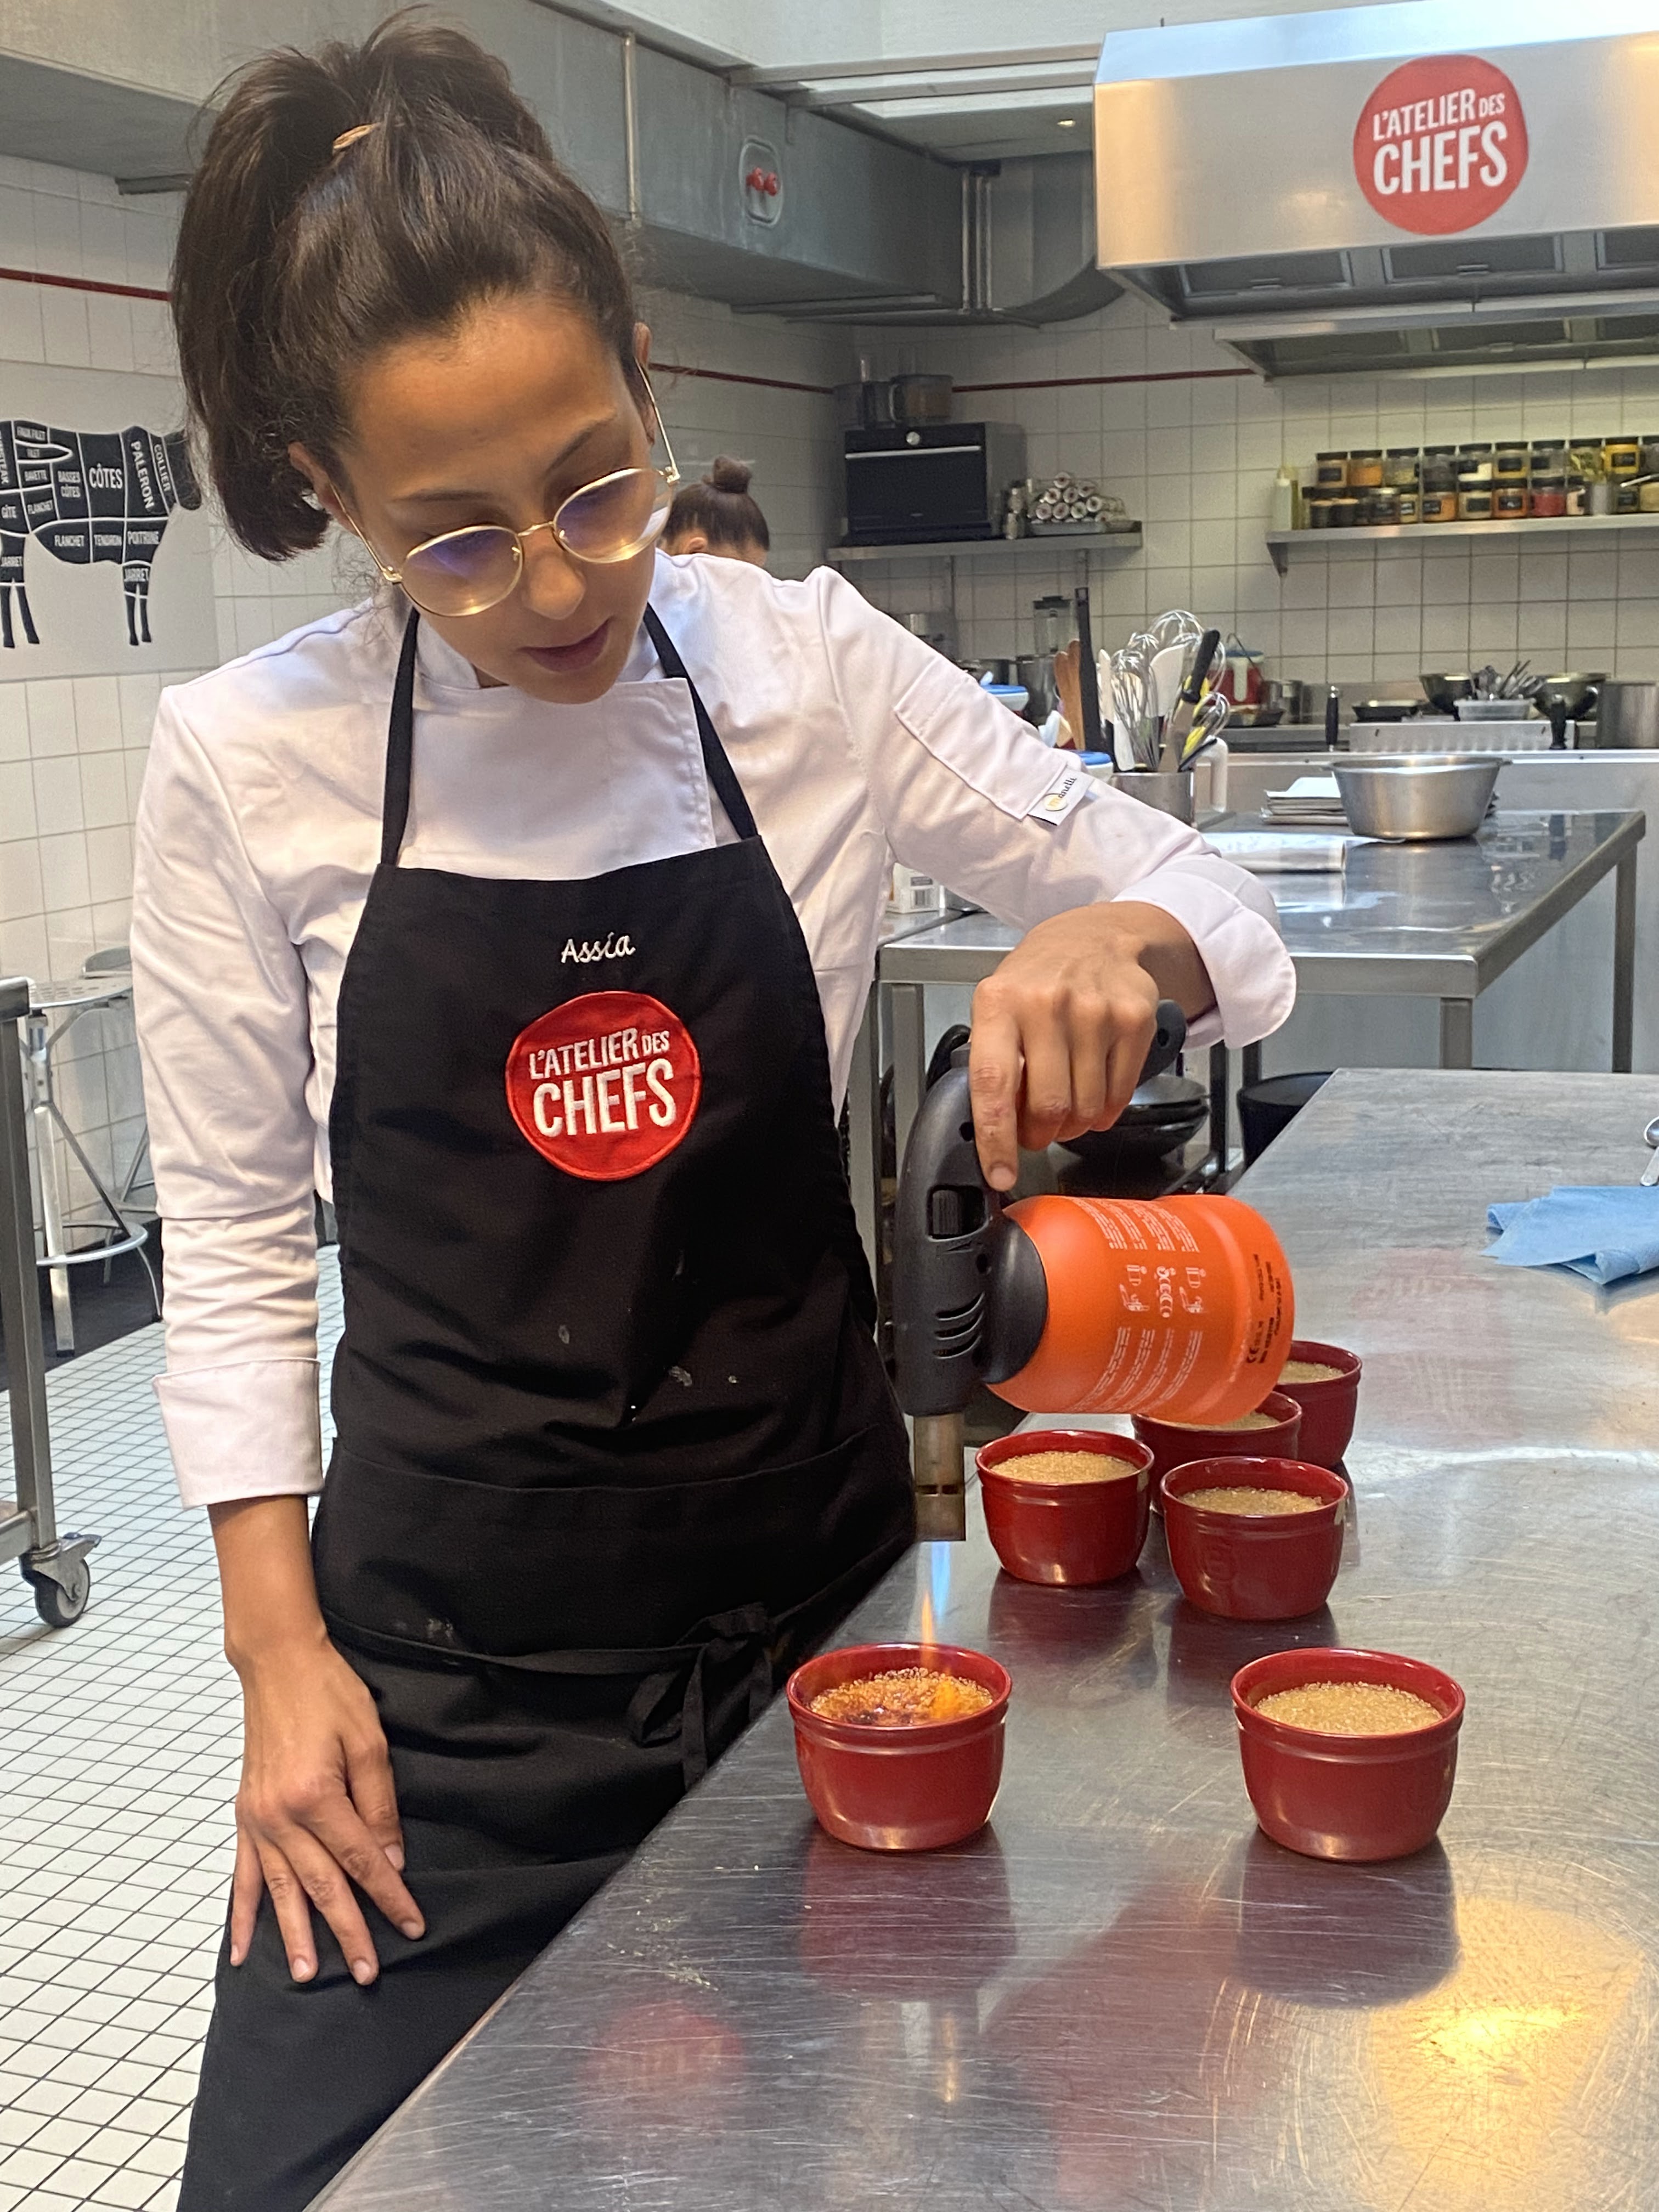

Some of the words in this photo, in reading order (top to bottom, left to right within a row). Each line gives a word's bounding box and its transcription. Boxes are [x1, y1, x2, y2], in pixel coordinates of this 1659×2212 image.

[1373, 88, 1476, 141] L'ATELIER
[1479, 93, 1505, 117] DES
[1373, 120, 1508, 195] CHEFS
[89, 462, 123, 489] CÔTES
[131, 441, 155, 509] PALERON
[154, 444, 171, 492] COLLIER
[561, 932, 636, 963] Assia
[529, 1028, 638, 1080] L'ATELIER
[642, 1030, 670, 1057] DES
[533, 1058, 676, 1137] CHEFS
